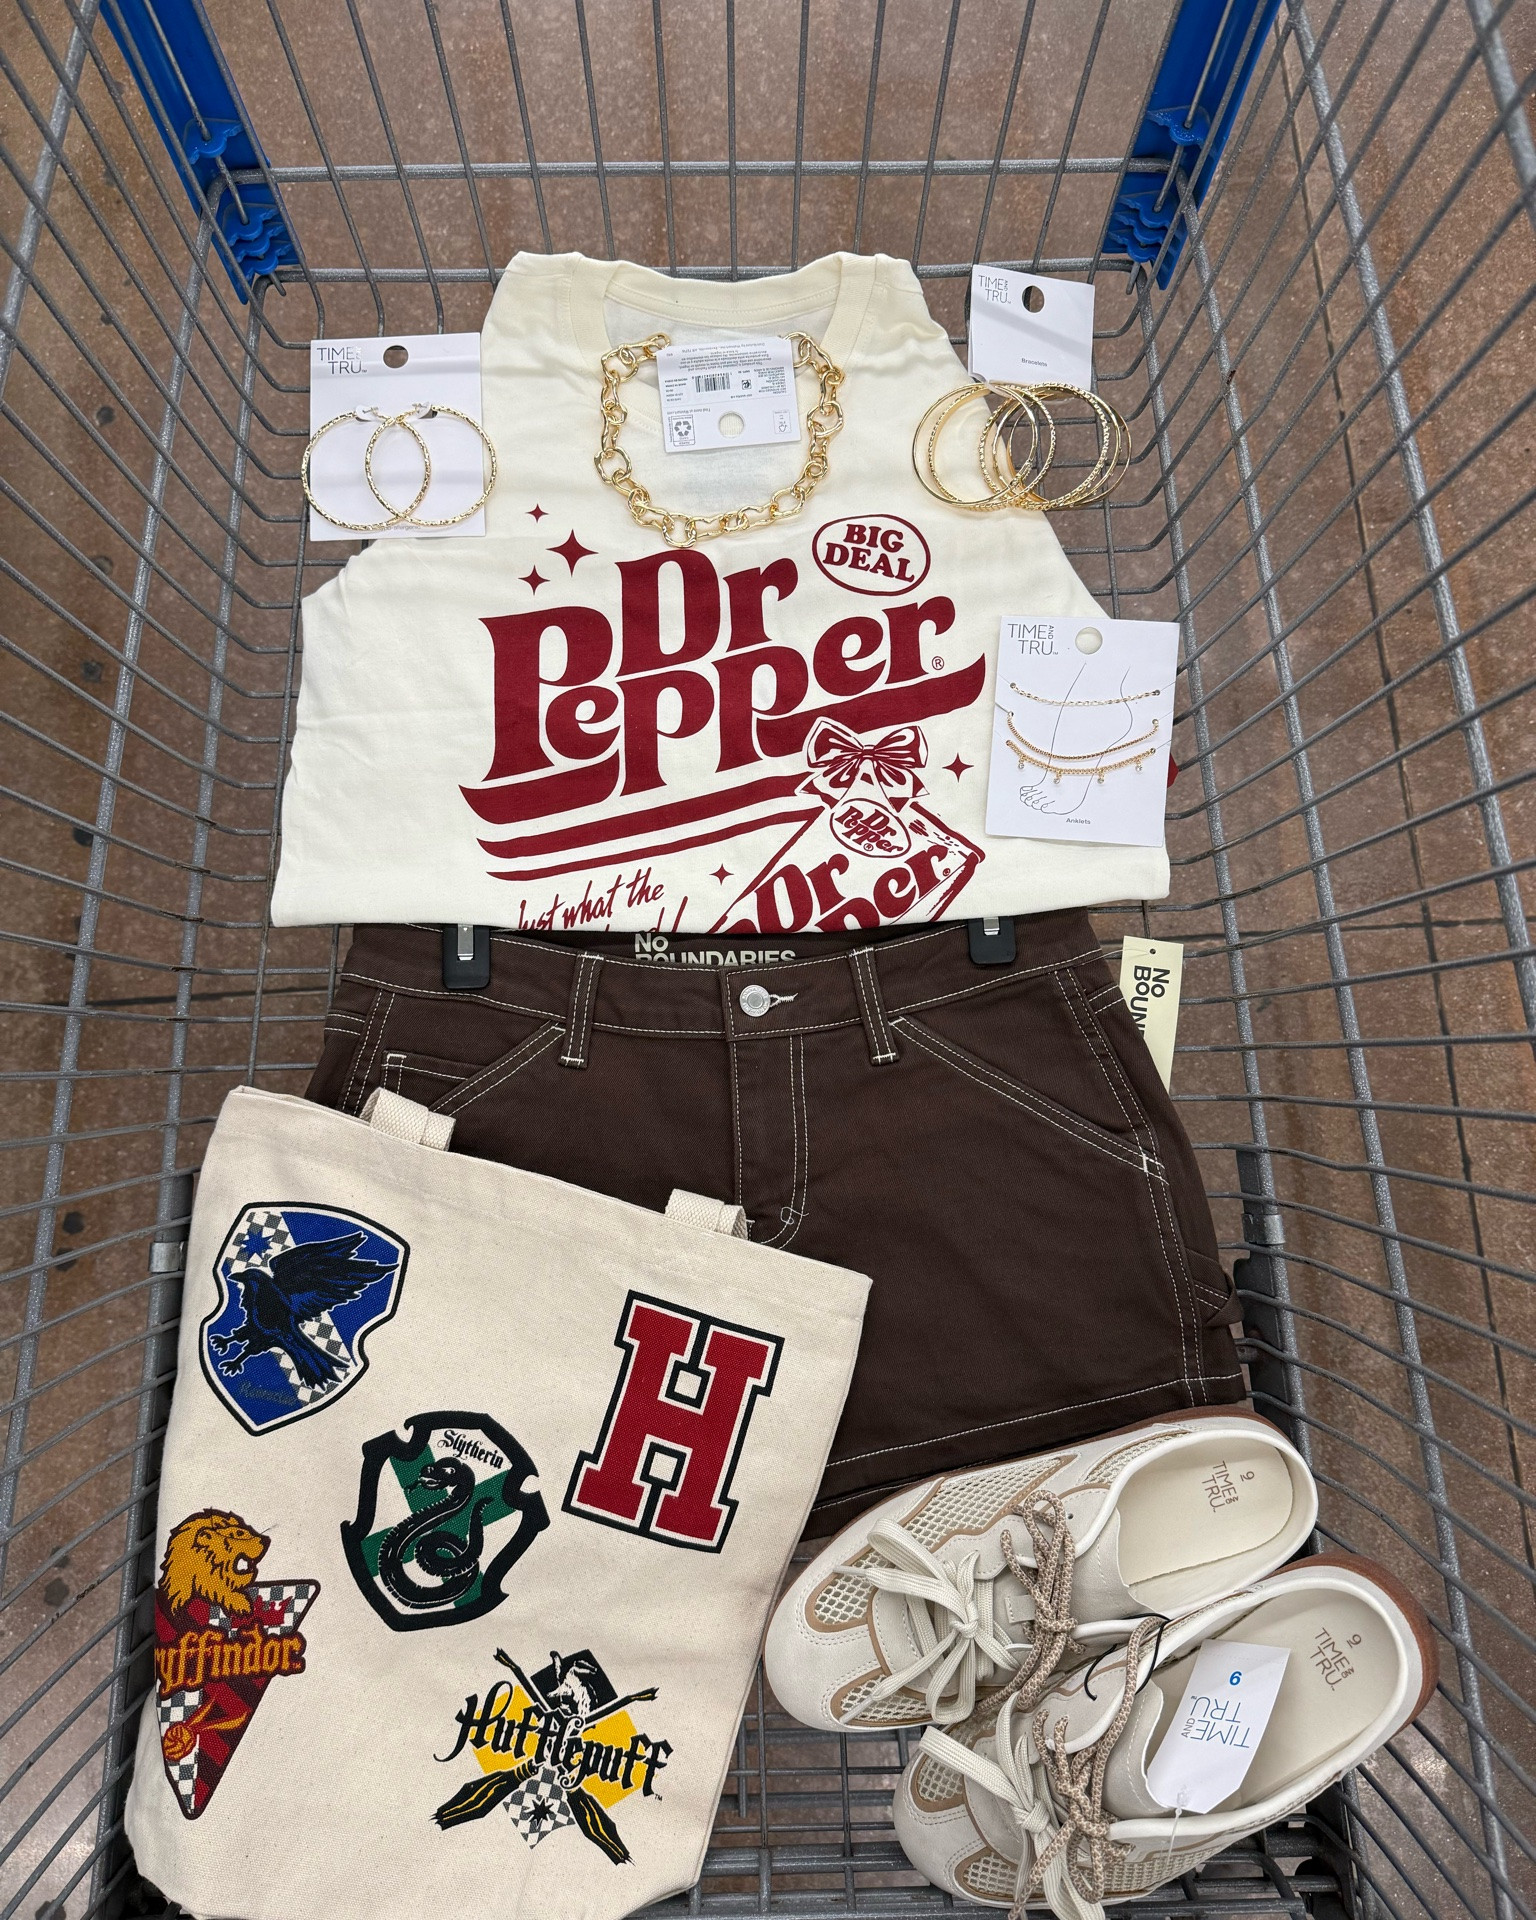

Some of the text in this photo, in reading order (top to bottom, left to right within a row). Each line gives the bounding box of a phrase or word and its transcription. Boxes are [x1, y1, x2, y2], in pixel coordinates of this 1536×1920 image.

[979, 275, 1004, 291] TIME
[316, 346, 355, 361] TIME
[1021, 357, 1048, 367] Bracelets
[843, 524, 904, 553] BIG
[822, 542, 915, 583] DEAL
[614, 549, 798, 677] Dr
[1007, 623, 1048, 639] TIME
[478, 596, 956, 797] Pepper
[834, 805, 904, 853] Pepper
[860, 808, 897, 837] Dr
[1066, 817, 1091, 825] Anklets
[562, 874, 625, 928] what
[626, 867, 665, 908] the
[754, 853, 850, 934] Dr
[1151, 967, 1171, 998] NO
[1130, 965, 1152, 1039] BOUN
[561, 1289, 785, 1554] H
[437, 1429, 504, 1469] Slytherin
[1212, 1460, 1237, 1498] TIME
[1242, 1471, 1255, 1481] 9
[1315, 1627, 1350, 1672] TIME
[1348, 1634, 1362, 1646] 9
[1190, 1696, 1241, 1723] TRU
[433, 1680, 674, 1797] Hufflepuff
[1181, 1717, 1250, 1748] TIME AND
